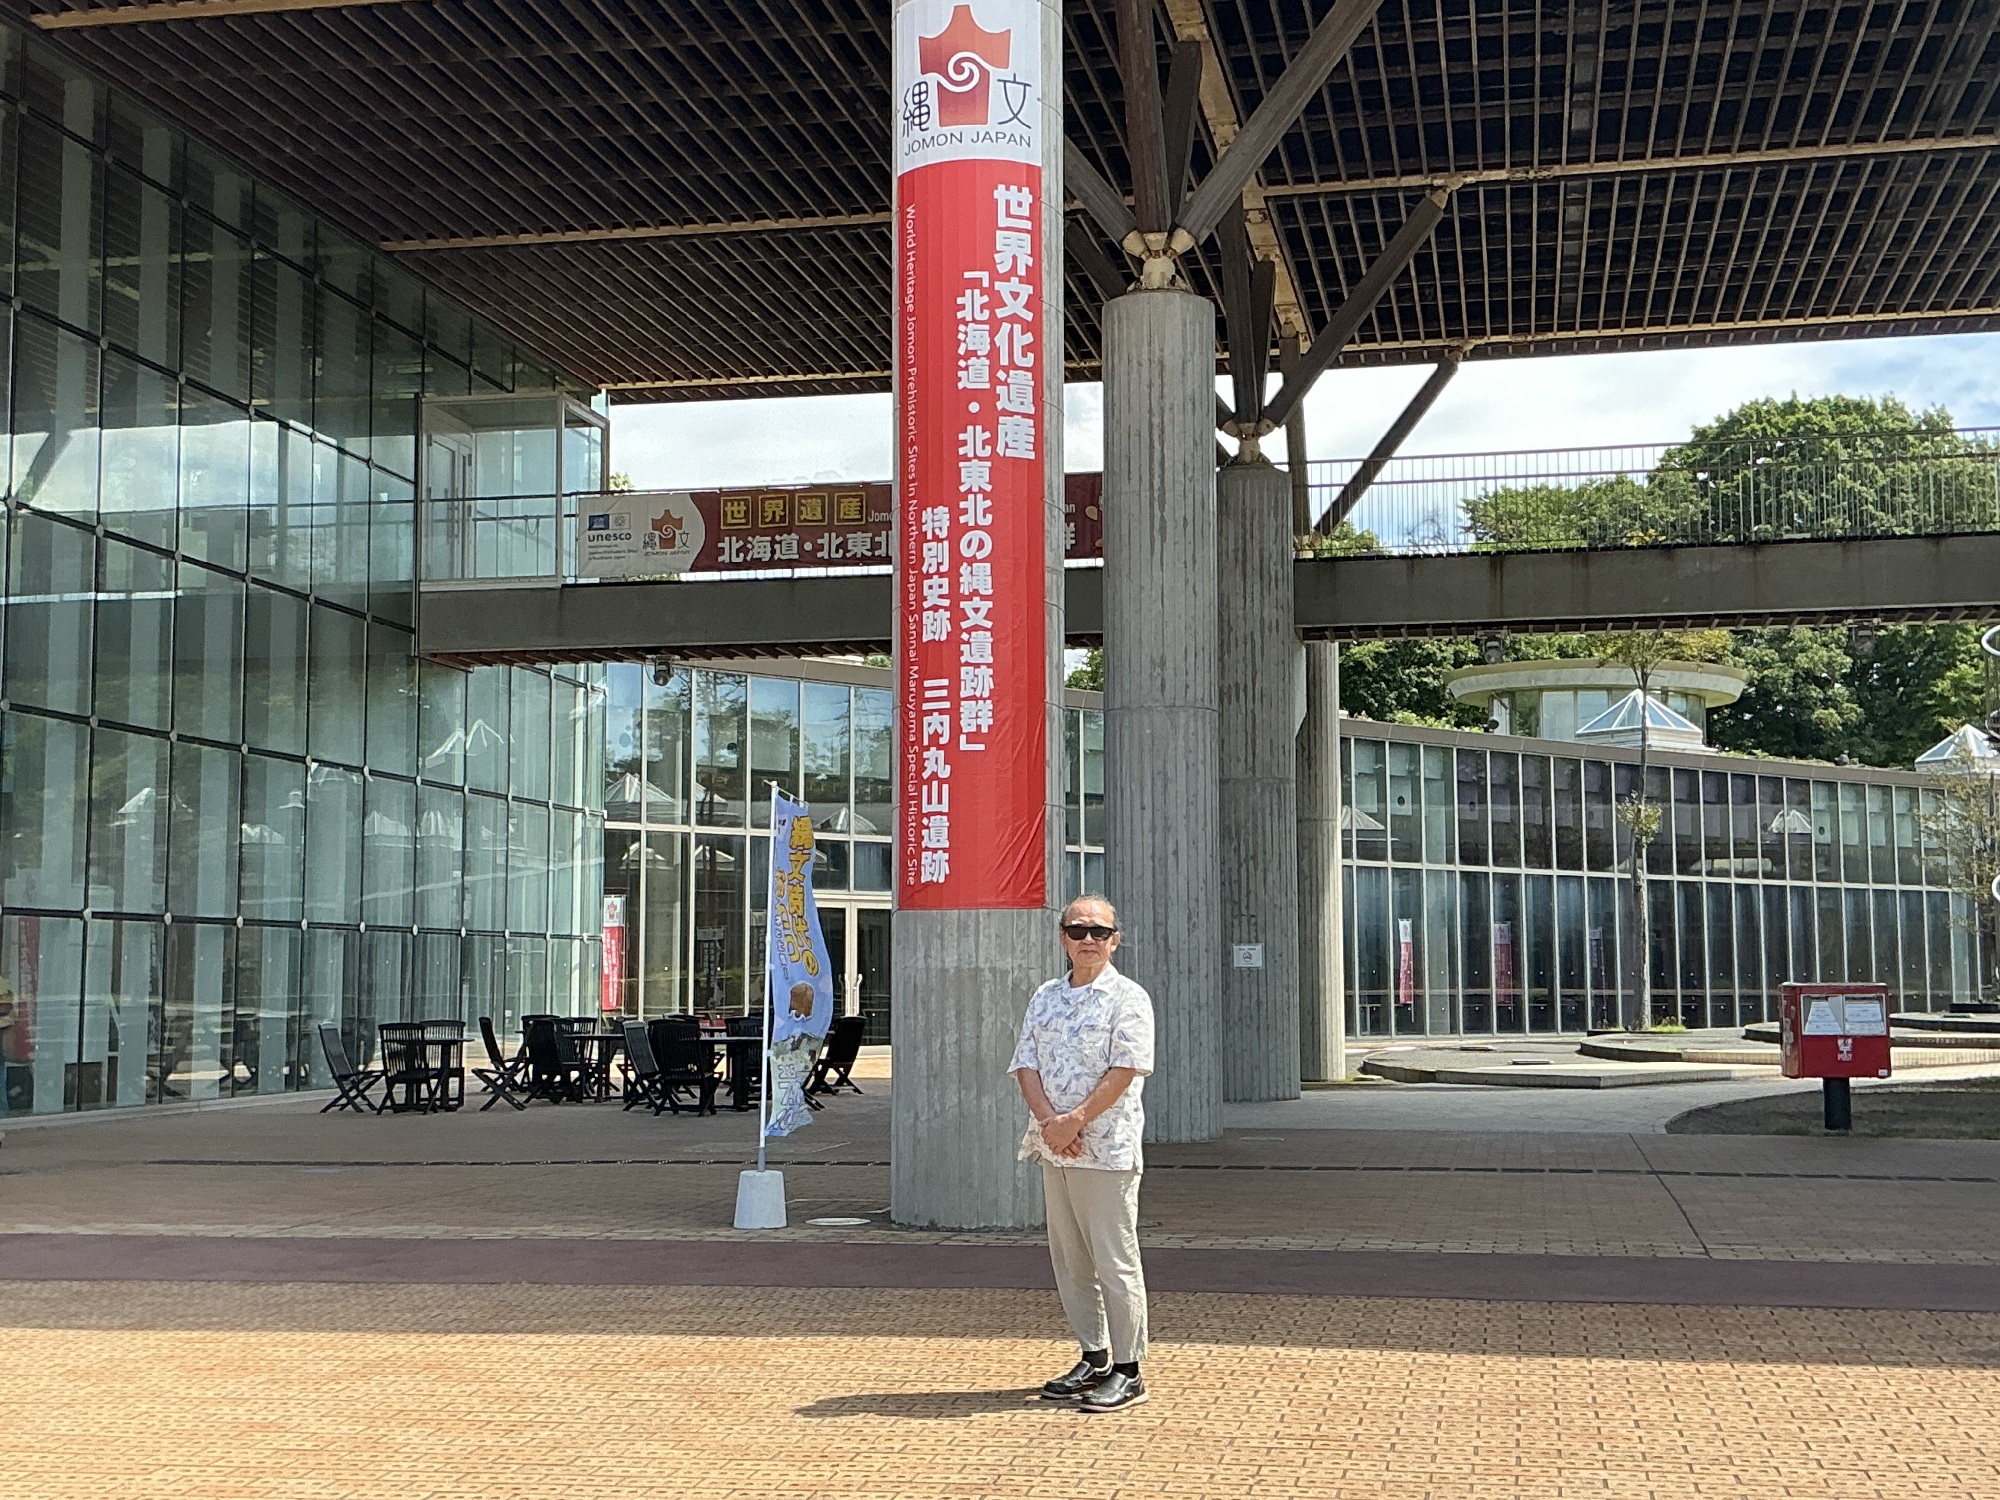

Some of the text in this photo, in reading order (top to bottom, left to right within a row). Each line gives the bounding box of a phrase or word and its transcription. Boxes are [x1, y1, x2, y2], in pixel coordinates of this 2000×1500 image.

[902, 73, 1032, 138] 縄 文
[904, 131, 1031, 156] JOMON JAPAN
[906, 204, 917, 249] World
[904, 251, 917, 313] Heritage
[906, 316, 917, 364] Jomon
[994, 184, 1036, 460] 世界文化遺産
[907, 367, 918, 442] Prehistoric
[908, 445, 918, 480] Sites
[725, 498, 862, 524] 世界遺産
[908, 500, 919, 565] Northern
[956, 270, 995, 751] 「北海道・北東北の縄文遺跡群」
[588, 532, 632, 542] unesco
[907, 568, 919, 610] Japan
[908, 613, 919, 662] Sannai
[906, 665, 919, 742] Maruyama
[920, 505, 951, 884] 特別史跡 三内丸山遺跡
[906, 746, 919, 796] Special
[907, 800, 918, 855] Historic
[906, 858, 918, 886] Site
